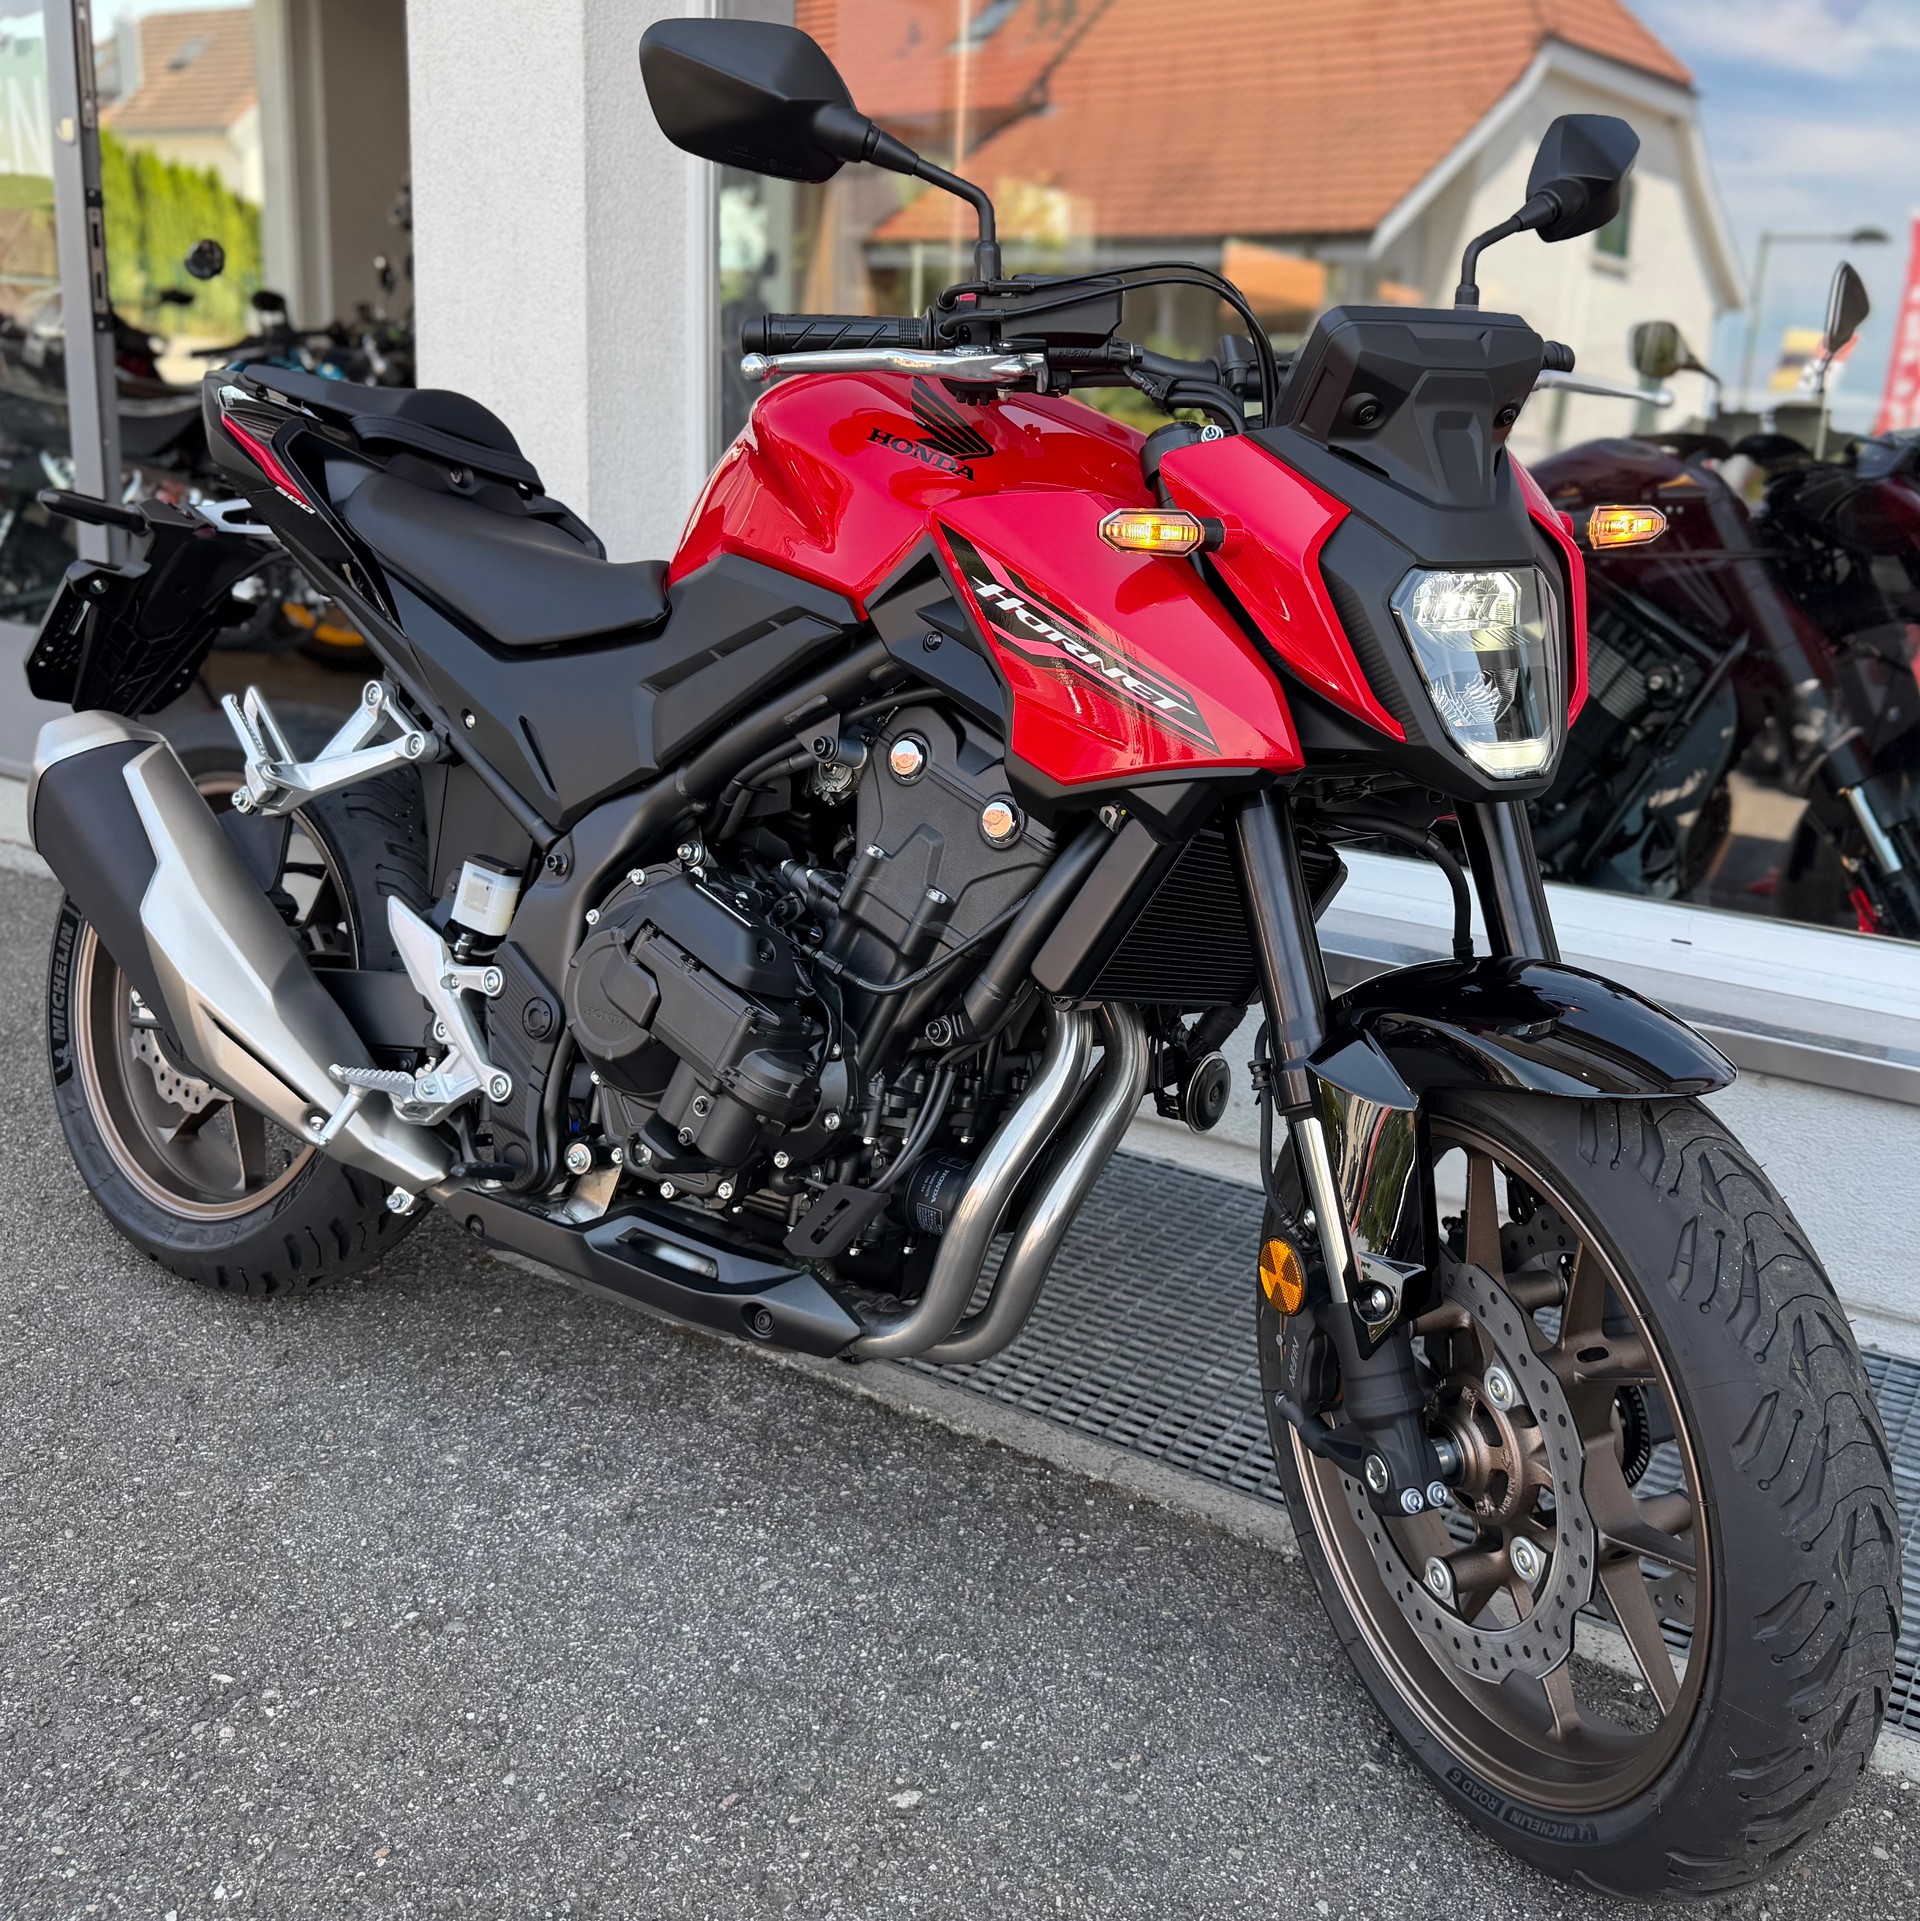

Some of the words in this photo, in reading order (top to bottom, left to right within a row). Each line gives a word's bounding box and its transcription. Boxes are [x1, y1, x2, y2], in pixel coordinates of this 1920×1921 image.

[866, 427, 975, 482] HONDA
[274, 485, 316, 515] 500
[971, 575, 1198, 716] HORNET
[52, 922, 75, 1041] MICHELIN
[583, 1003, 631, 1029] HONDA
[931, 1169, 950, 1203] HONDA
[1449, 1769, 1462, 1783] 6
[1461, 1781, 1499, 1811] ROAD
[1509, 1809, 1577, 1840] MICHELIN
